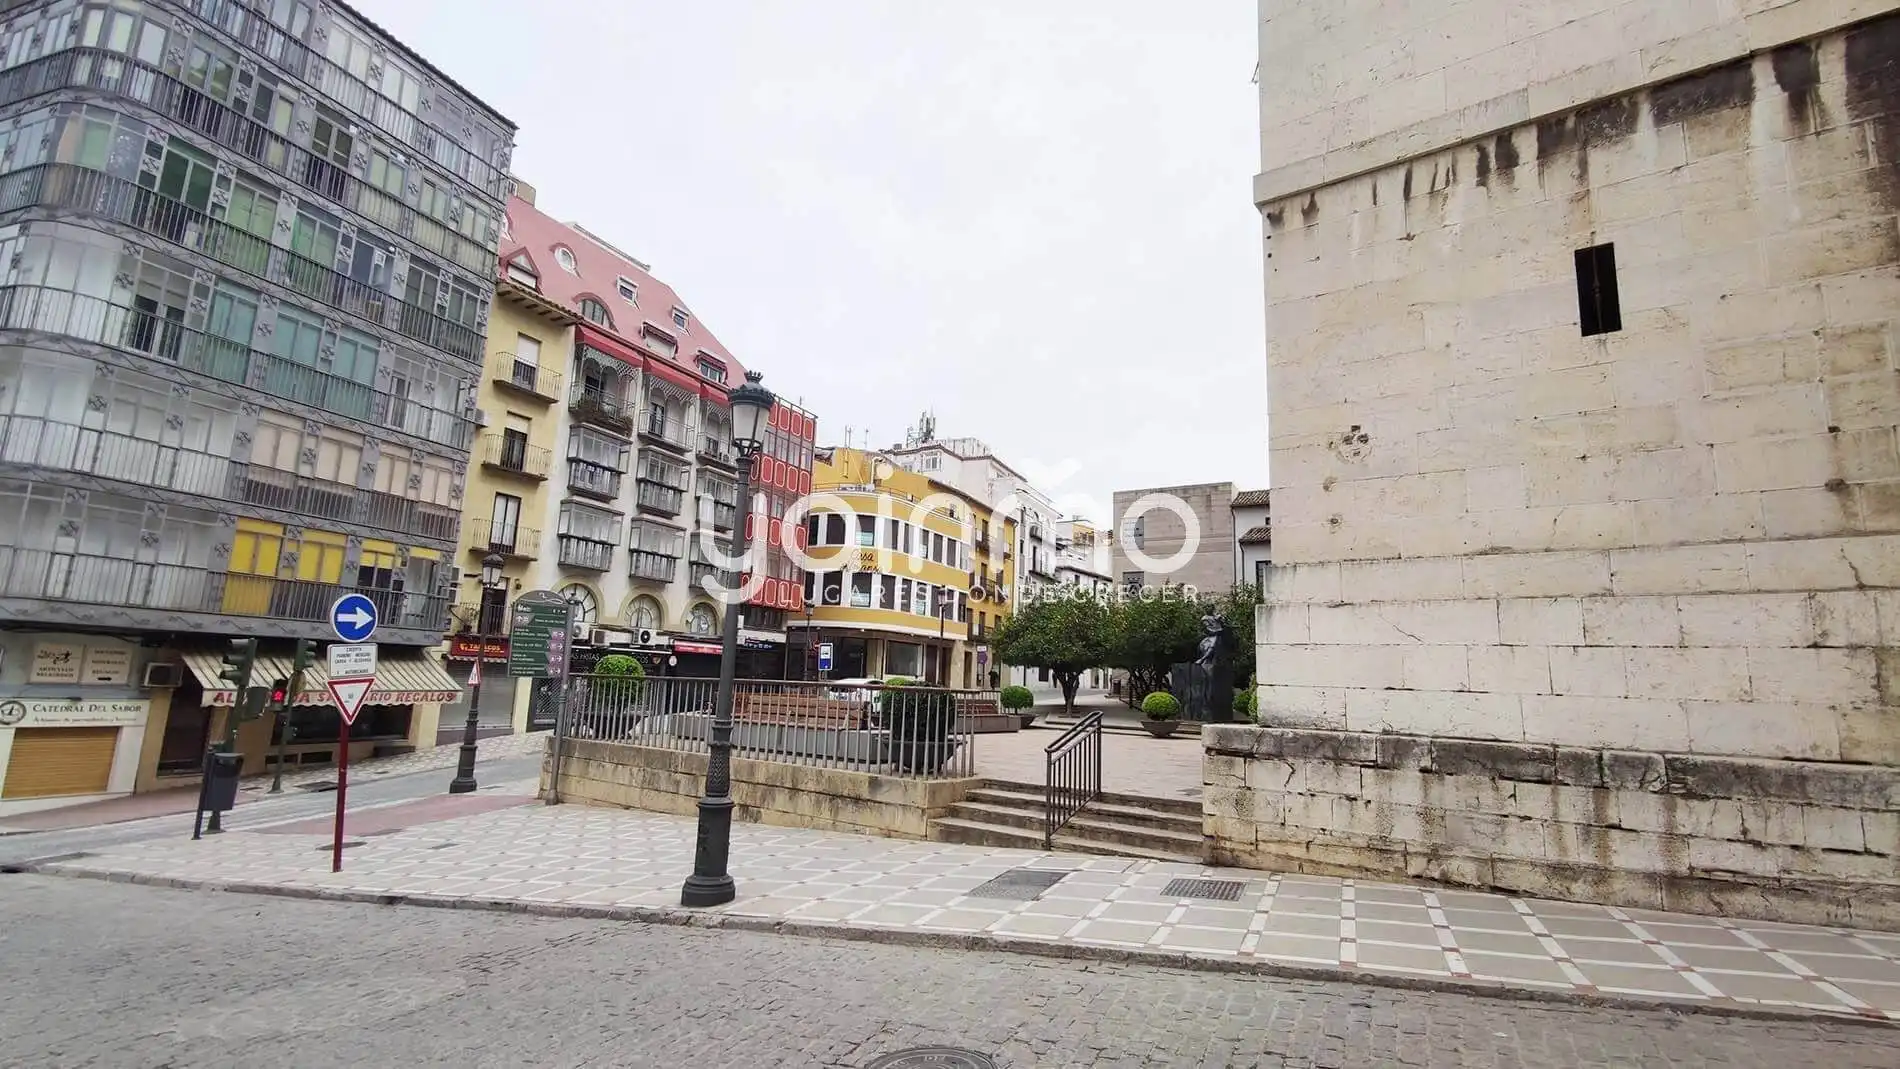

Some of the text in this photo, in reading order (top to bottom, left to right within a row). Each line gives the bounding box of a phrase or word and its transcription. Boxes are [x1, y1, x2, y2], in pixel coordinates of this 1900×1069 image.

[396, 692, 455, 702] REGALOS
[32, 703, 143, 714] CATEDRAL DEL SABOR
